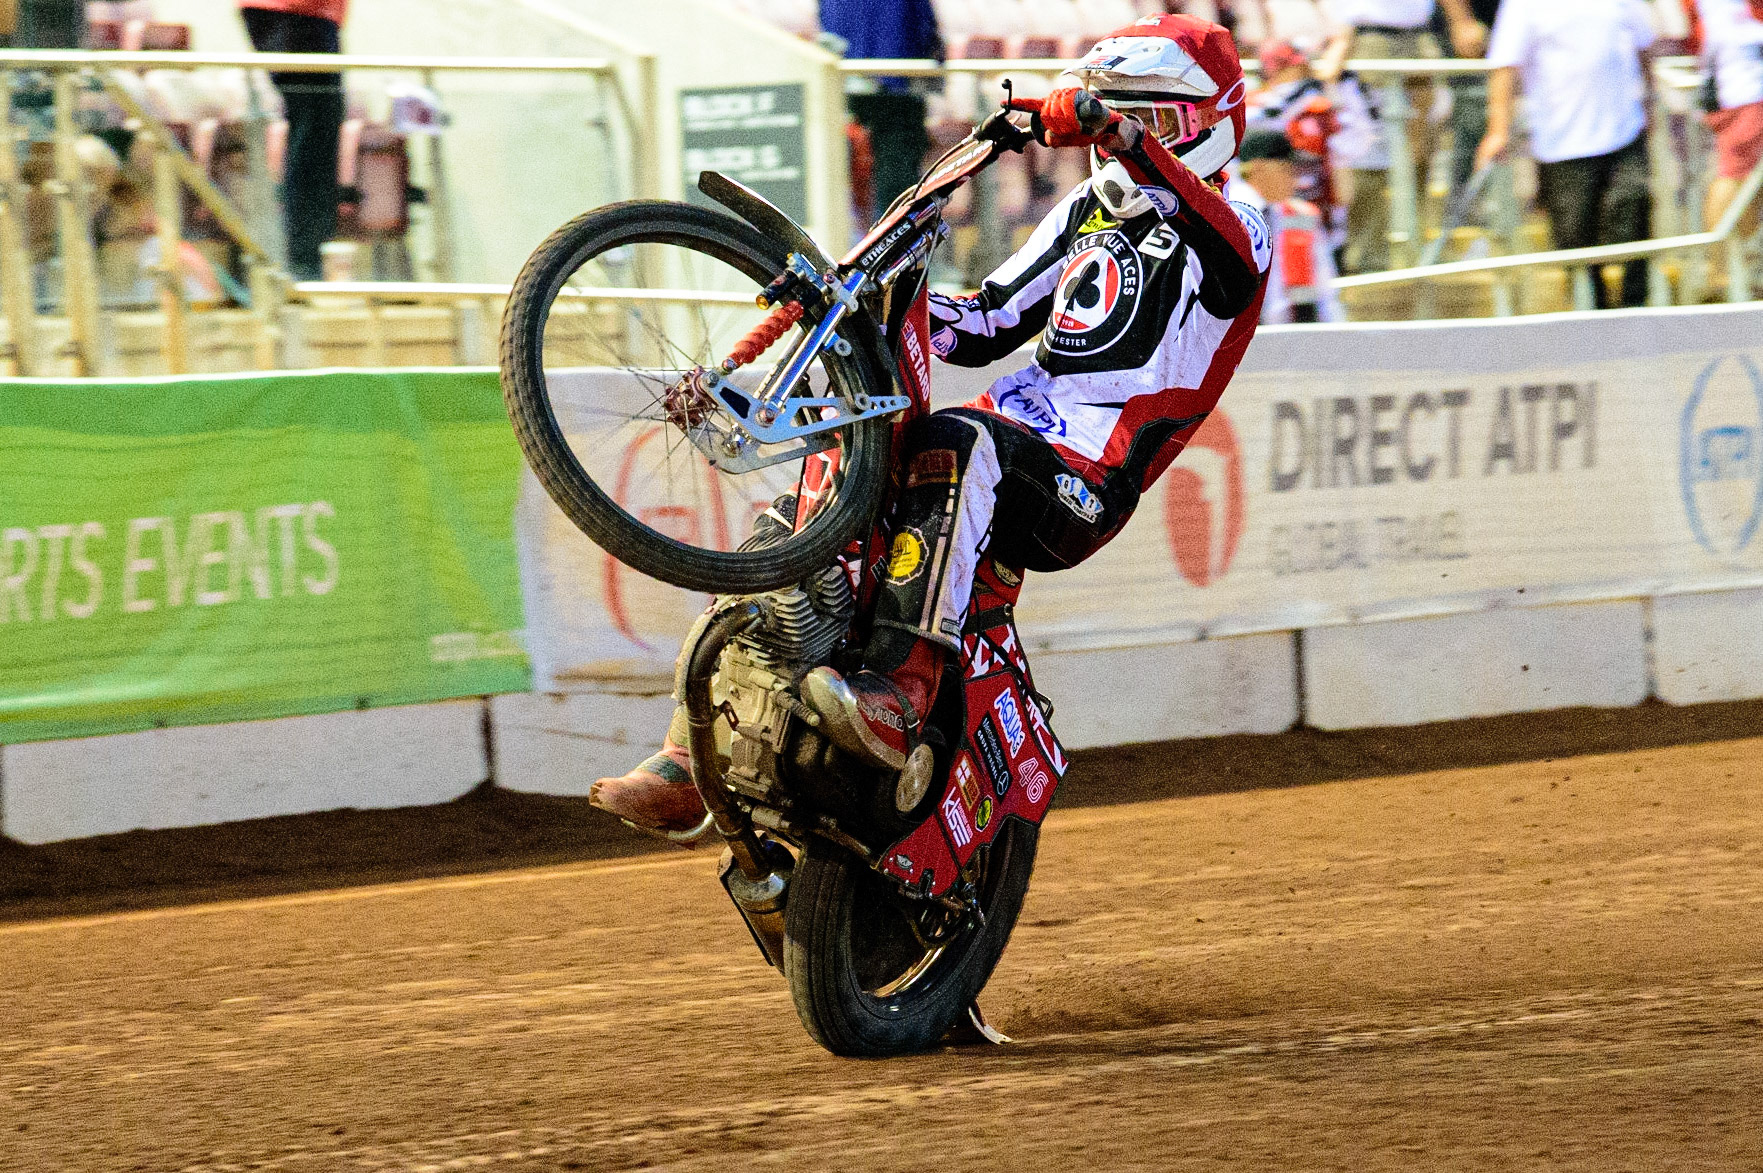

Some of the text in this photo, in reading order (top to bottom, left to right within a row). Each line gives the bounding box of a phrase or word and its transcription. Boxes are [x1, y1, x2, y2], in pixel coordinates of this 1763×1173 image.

[1103, 233, 1126, 255] VUE
[1120, 257, 1136, 296] ACES
[1149, 227, 1174, 249] 5
[906, 331, 930, 402] BETARD
[1270, 388, 1472, 491] DIRECT
[1482, 380, 1598, 477] ATPI
[123, 500, 338, 613] EVENTS
[1018, 757, 1050, 804] 46
